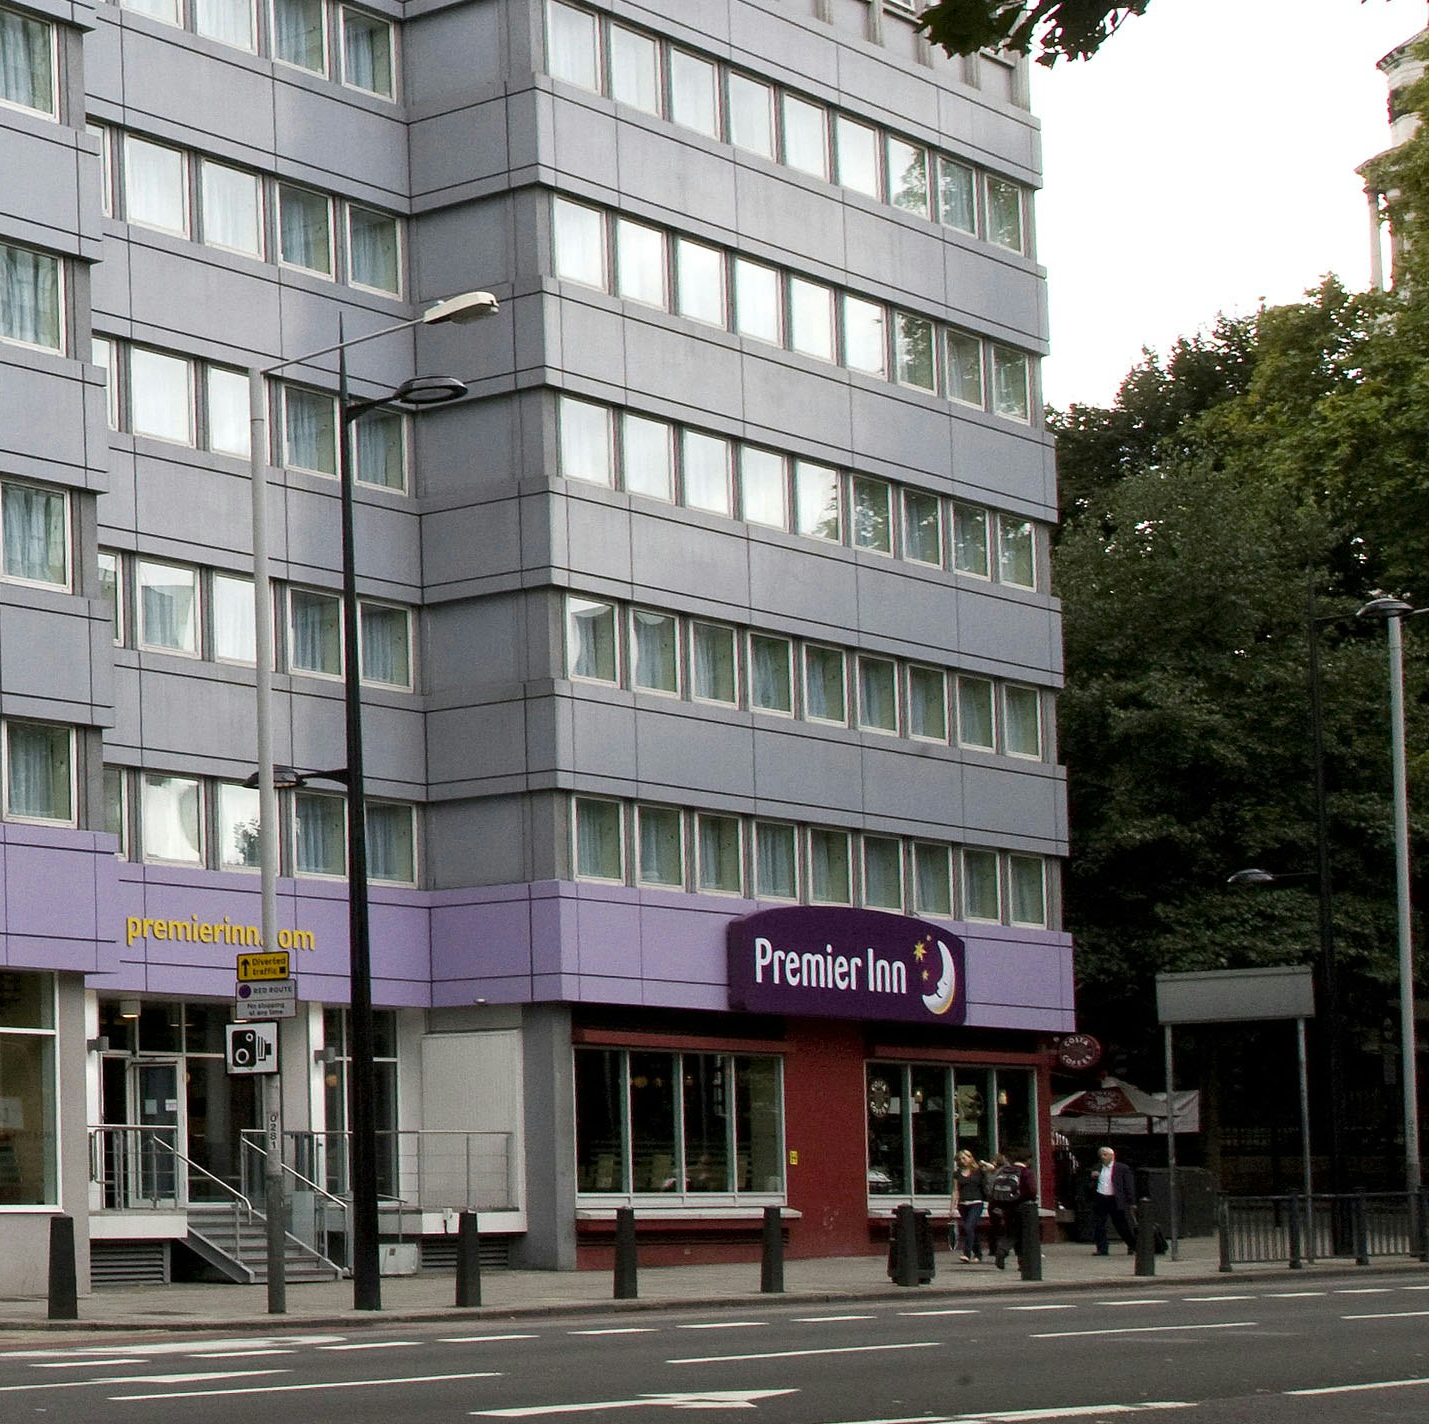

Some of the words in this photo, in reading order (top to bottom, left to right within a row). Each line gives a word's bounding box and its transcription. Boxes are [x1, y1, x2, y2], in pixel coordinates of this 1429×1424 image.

[126, 914, 316, 951] premierinn.om
[252, 958, 286, 966] Diverted
[755, 938, 862, 991] Premier
[867, 948, 907, 994] Inn
[253, 967, 278, 976] traffic
[1064, 1037, 1089, 1047] COSTA
[1062, 1054, 1092, 1066] COFFEE
